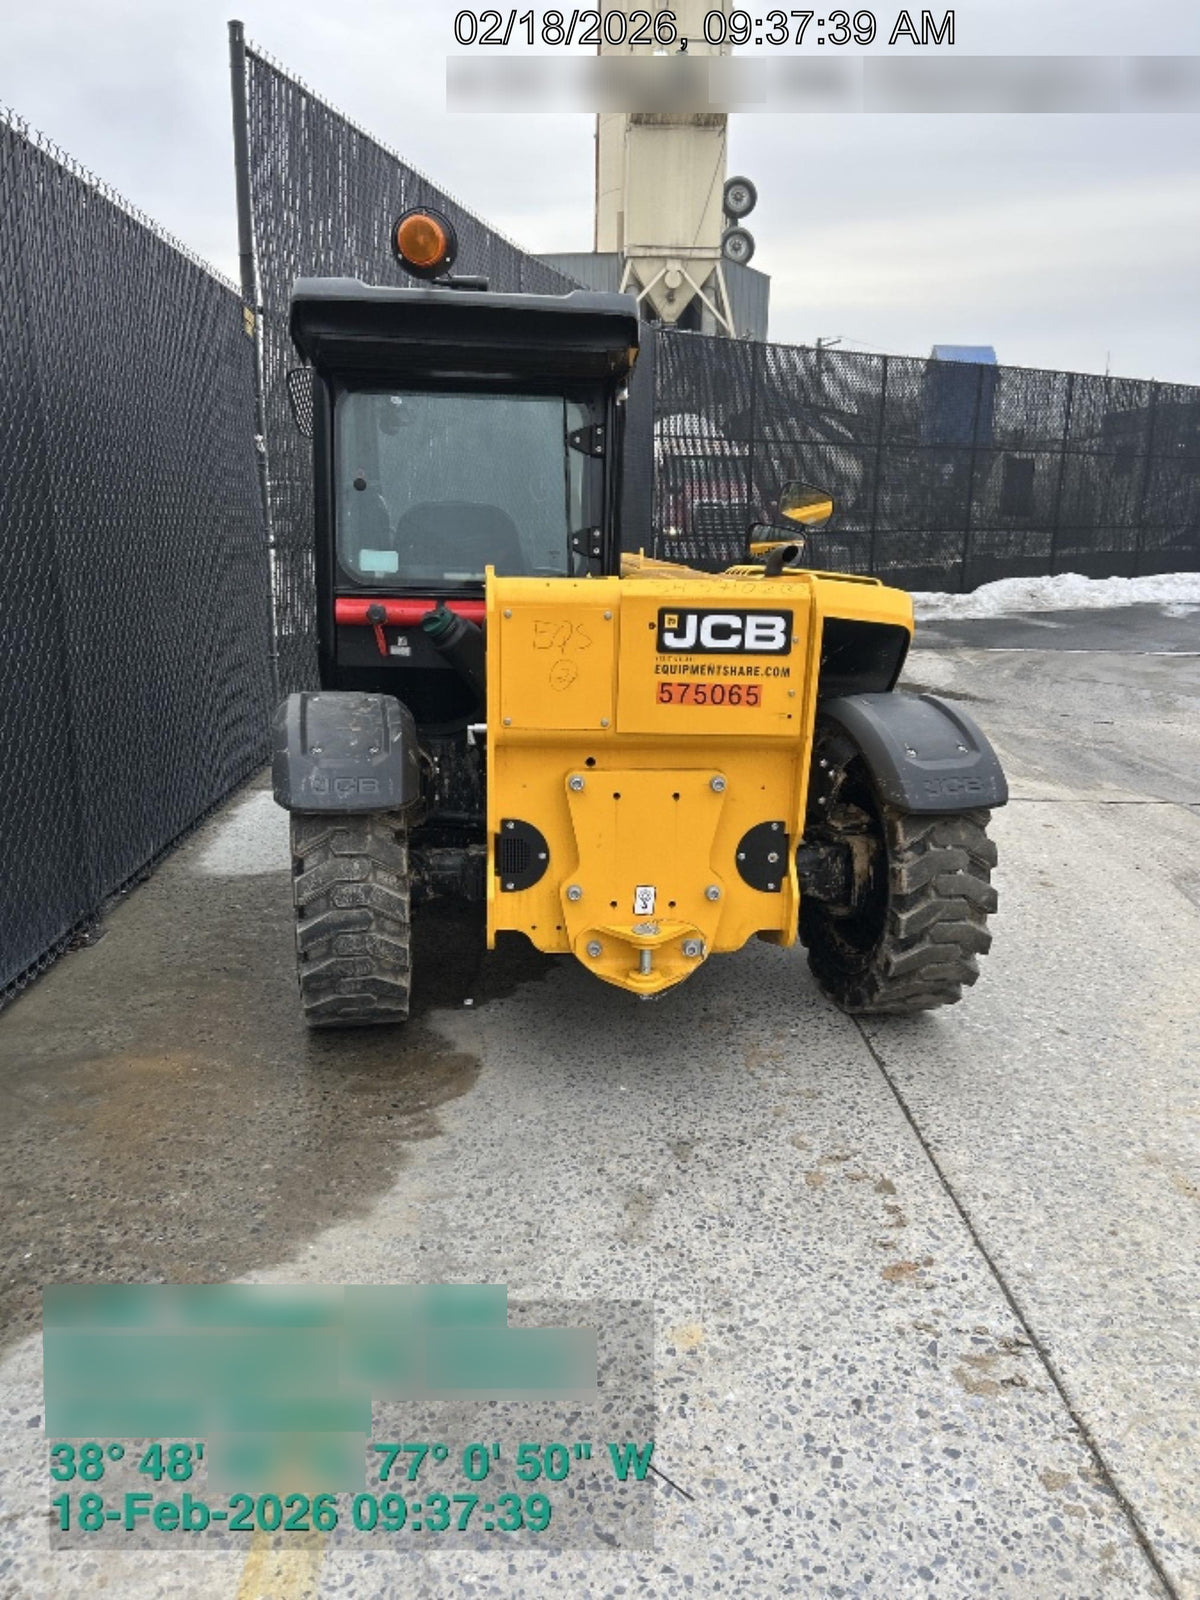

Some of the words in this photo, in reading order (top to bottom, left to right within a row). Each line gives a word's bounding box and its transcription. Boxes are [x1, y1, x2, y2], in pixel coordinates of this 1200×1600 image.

[663, 614, 786, 649] JCB
[654, 664, 791, 678] EQUIPMENTSHARE.COM
[659, 682, 759, 706] 575065
[312, 776, 380, 795] JCB
[923, 776, 985, 797] JCB
